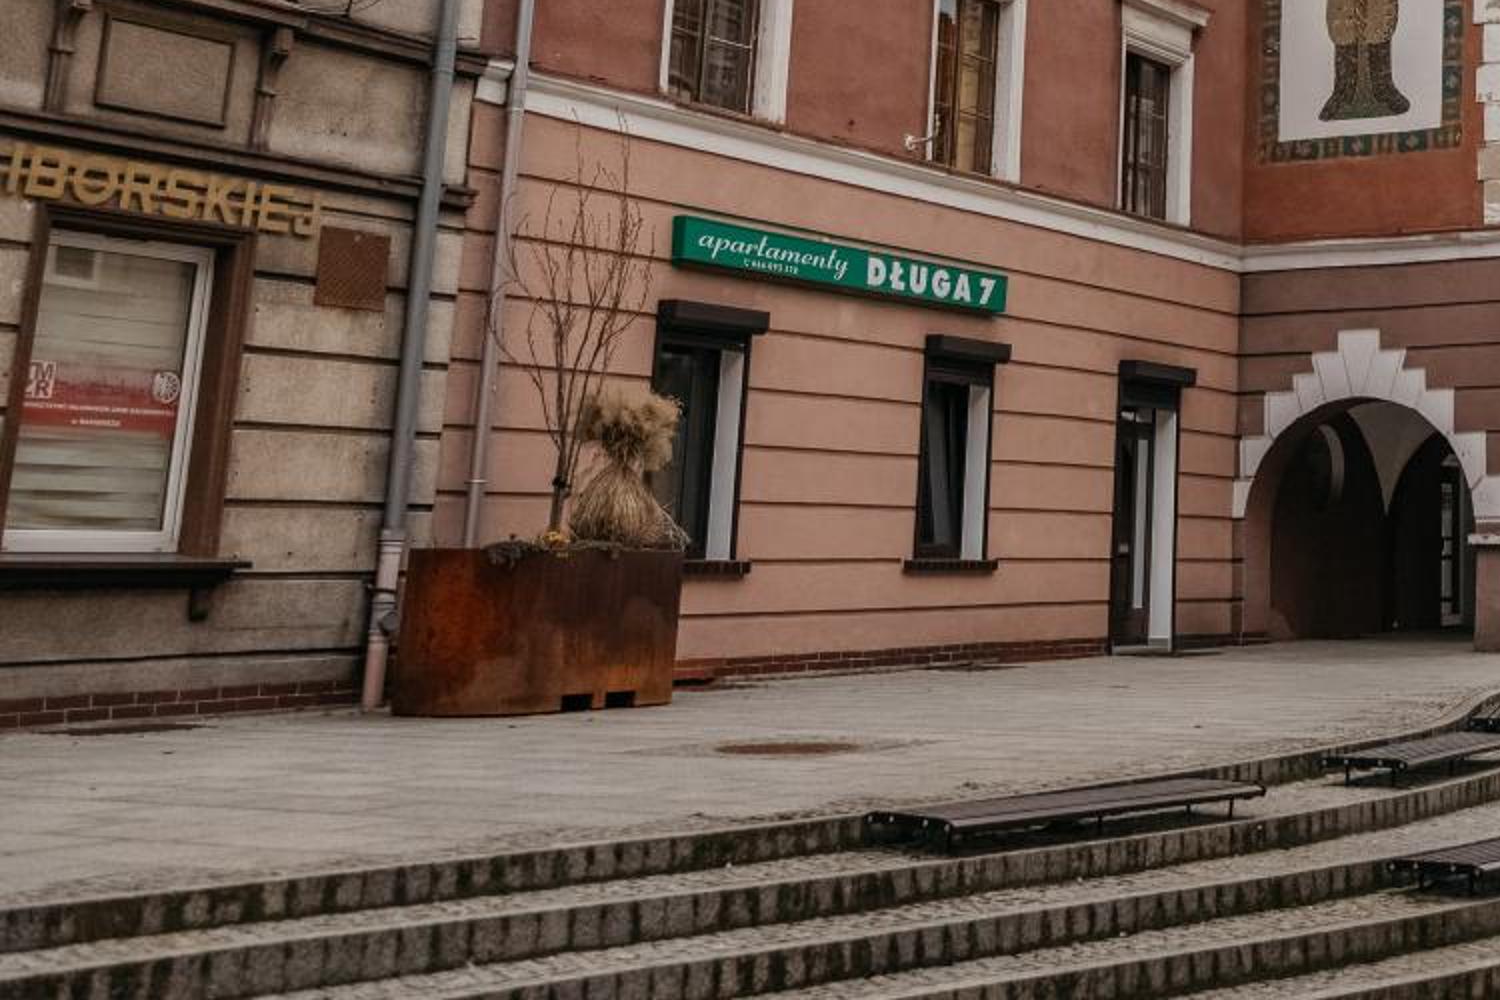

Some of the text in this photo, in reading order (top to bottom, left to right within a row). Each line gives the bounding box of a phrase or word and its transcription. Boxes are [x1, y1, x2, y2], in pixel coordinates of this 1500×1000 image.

[698, 234, 997, 305] apartamenty DŁUGA 7
